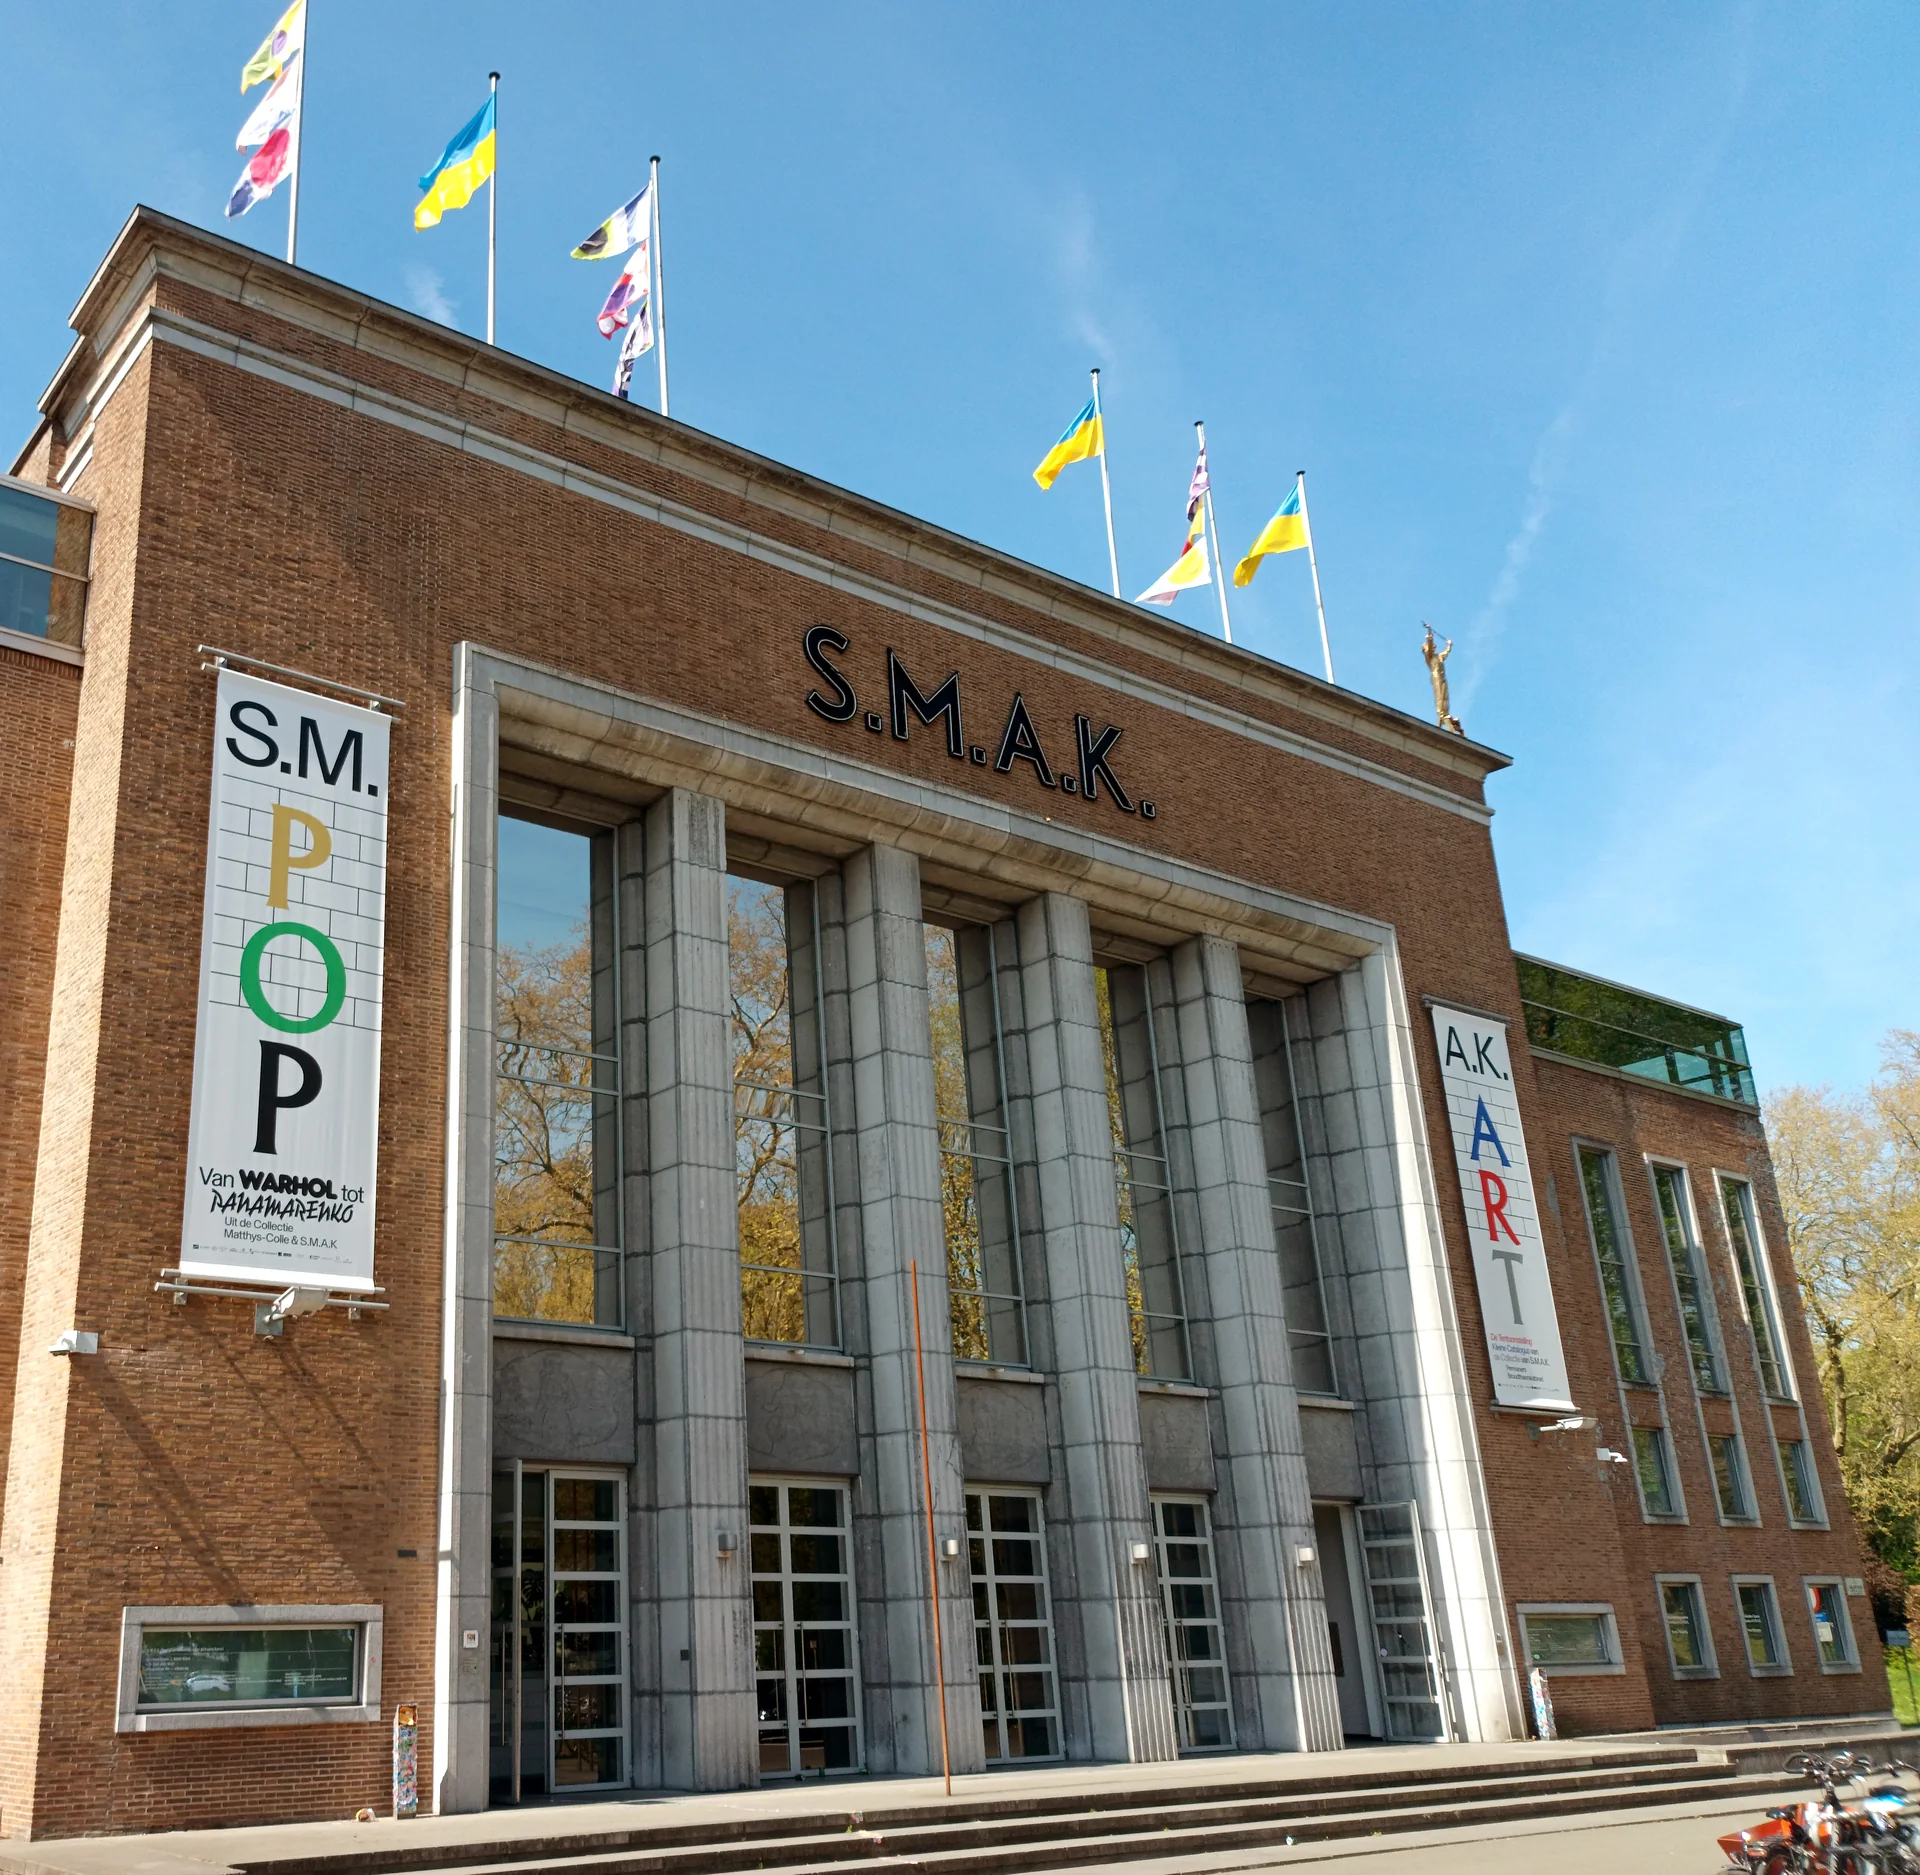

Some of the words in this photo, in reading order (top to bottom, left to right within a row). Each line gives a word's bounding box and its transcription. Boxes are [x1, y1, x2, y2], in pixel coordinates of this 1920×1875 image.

[803, 624, 1156, 819] S.M.A.K.
[226, 701, 378, 797] S.M.
[1446, 1025, 1508, 1081] A.K.
[199, 1166, 235, 1189] Van
[239, 1169, 338, 1200] WARHOL
[341, 1184, 365, 1204] tot
[224, 1216, 238, 1227] Uit
[239, 1219, 252, 1229] de
[253, 1220, 294, 1233] Collectie
[224, 1228, 290, 1244] Matthys-Colle
[291, 1236, 299, 1246] &
